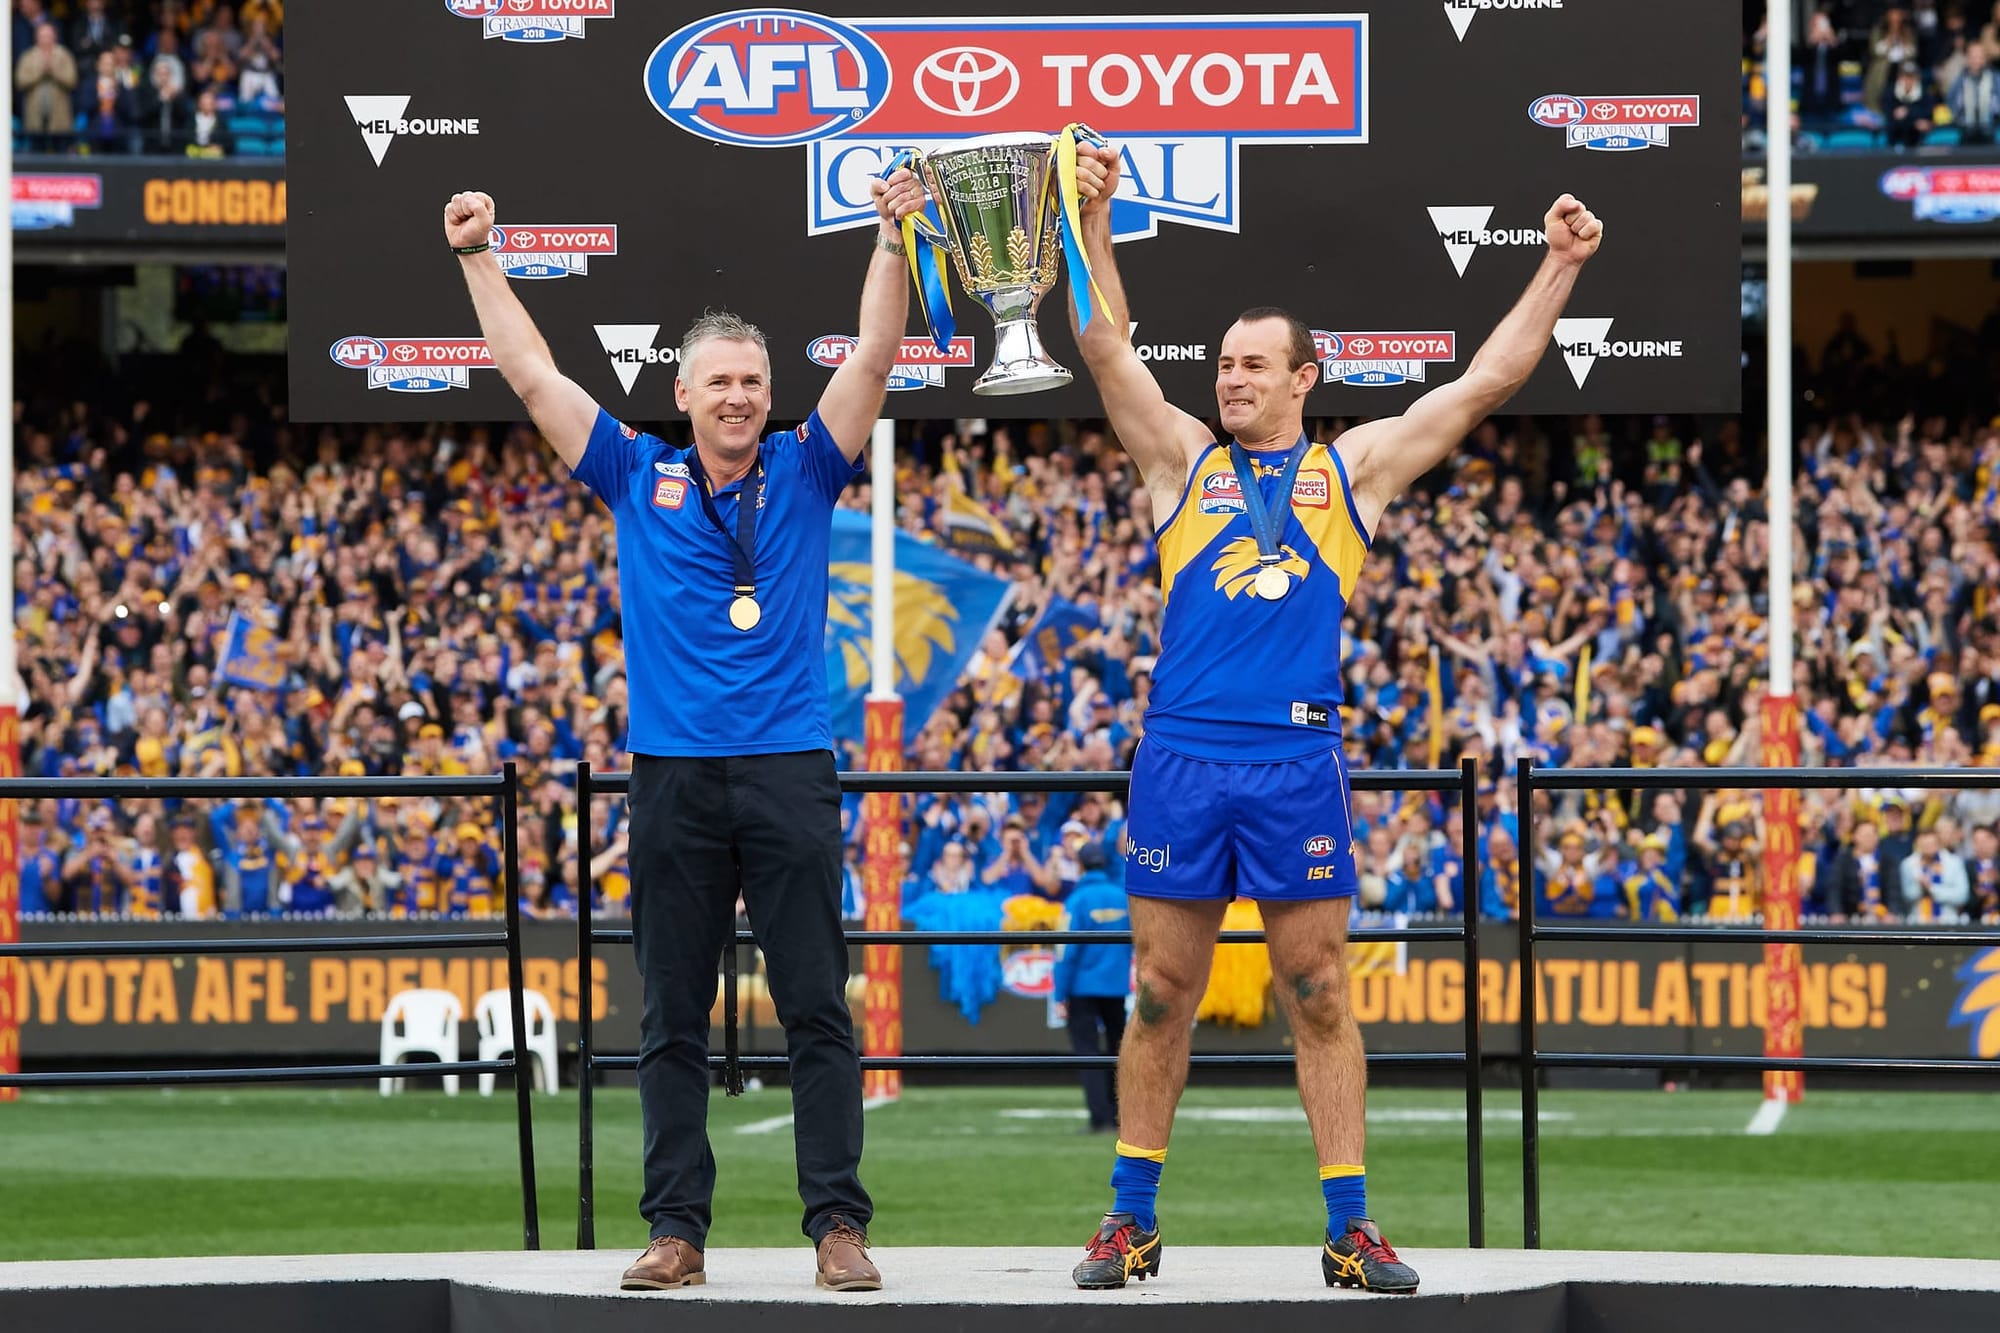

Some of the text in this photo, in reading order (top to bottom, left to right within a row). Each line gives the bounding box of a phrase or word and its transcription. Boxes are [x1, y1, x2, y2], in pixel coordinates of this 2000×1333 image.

[452, 0, 608, 10] AFL TOYOTA
[489, 17, 579, 33] GRAND FINAL
[522, 29, 546, 39] 2018
[668, 44, 1340, 109] AFL TOYOTA
[1534, 103, 1693, 119] AFL TOYOTA
[358, 118, 480, 135] MELBOURNE
[1571, 125, 1665, 142] GRAND FINAL
[1605, 138, 1629, 147] 2018
[942, 147, 1025, 175] AUSTRALIAN
[990, 163, 1030, 177] LEAGUE
[971, 176, 1000, 191] 2018
[541, 233, 610, 247] TOYOTA
[538, 253, 584, 270] FINAL
[525, 266, 549, 275] 2018
[335, 344, 492, 360] AFL TOYOTA
[1378, 340, 1448, 354] TOYOTA
[1561, 341, 1682, 357] MELBOURNE
[373, 367, 464, 383] GRAND FINAL
[896, 366, 940, 382] FINAL
[1328, 361, 1420, 377] GRAND FINAL
[407, 379, 430, 388] 2018
[887, 378, 906, 387] 018
[1362, 373, 1386, 382] 2018
[1207, 476, 1241, 490] AF
[658, 491, 681, 501] JACKS
[1293, 486, 1325, 497] JACKS
[1308, 711, 1327, 721] ISC
[1306, 840, 1334, 853] AFL
[1138, 844, 1170, 873] agl
[1307, 865, 1335, 880] ISC
[191, 958, 298, 1024] AFL
